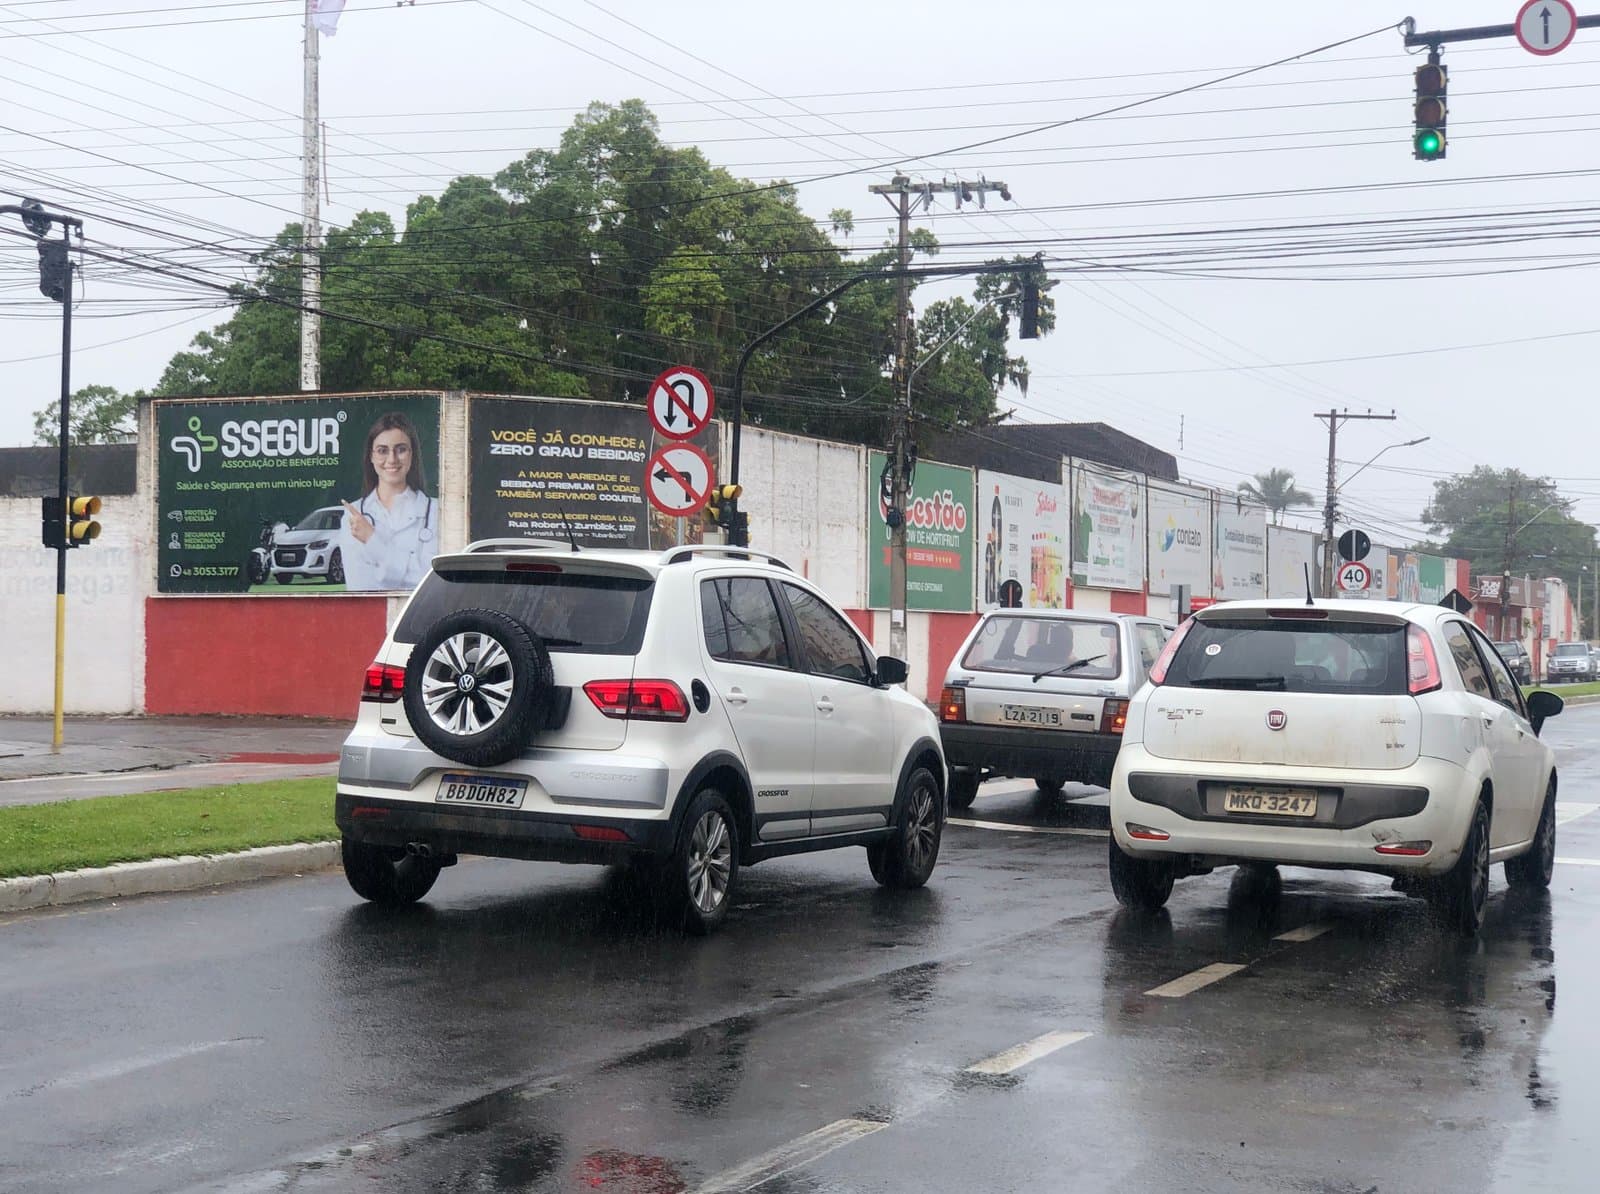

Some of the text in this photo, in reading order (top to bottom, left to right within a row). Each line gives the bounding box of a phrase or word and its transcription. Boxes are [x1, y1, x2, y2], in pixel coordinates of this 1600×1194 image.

[491, 429, 646, 450] VOCÊ JÁ CONHECE A
[490, 444, 647, 463] ZERO GRAU BEBIDAS?
[221, 457, 339, 469] ASSOCIAÇÃO DE BENEFÍCIOS
[518, 470, 527, 478] A
[529, 471, 563, 480] MAIOR
[566, 473, 618, 482] VARIEDADE
[176, 481, 203, 490] Saúde
[211, 480, 255, 491] Segurança
[288, 479, 312, 488] único
[313, 478, 337, 489] lugar
[501, 480, 641, 494] BEBIDAS PREMIUM DA CIDADE
[495, 489, 541, 499] TAMBÉM
[544, 490, 597, 501] SERVIMOS
[507, 512, 540, 520] VENHA
[508, 520, 529, 528] Rua
[1176, 528, 1202, 546] contato
[1343, 568, 1364, 583] 40
